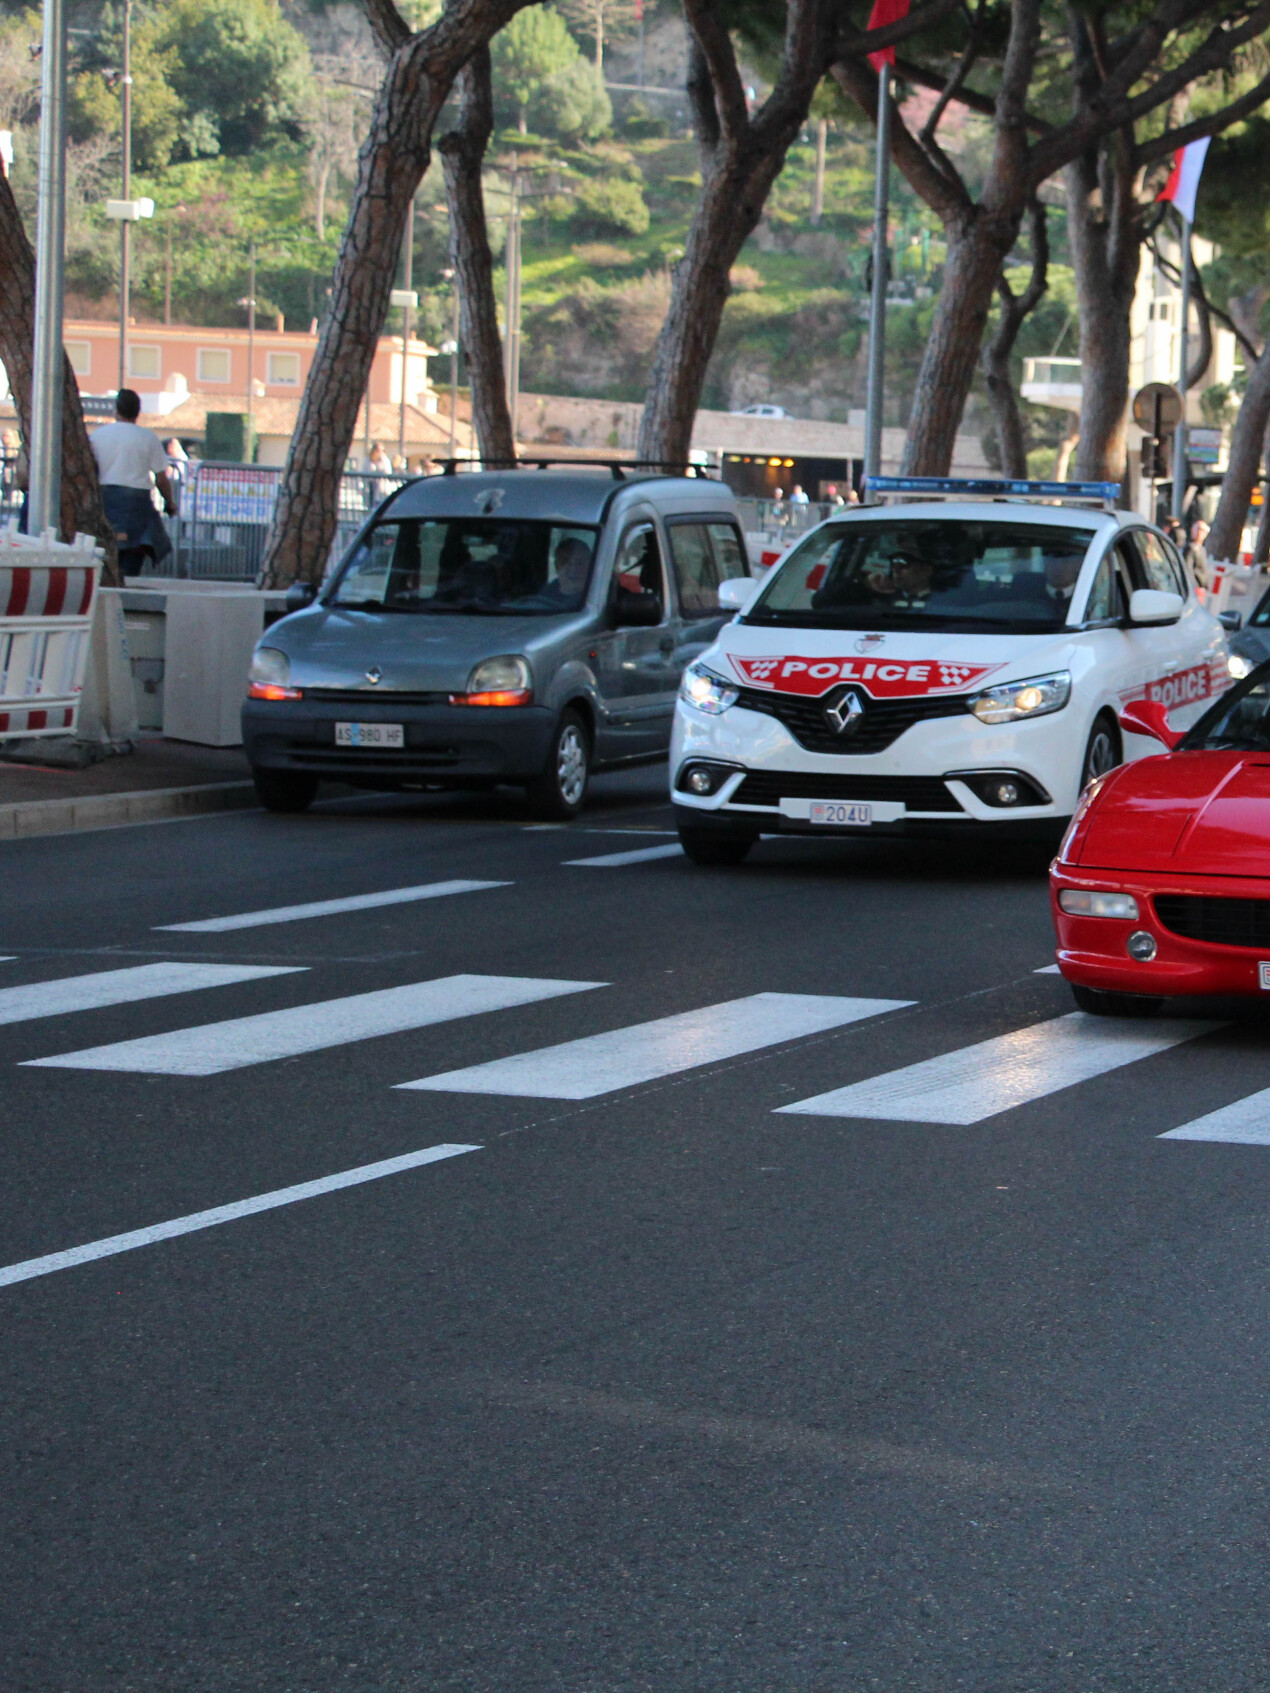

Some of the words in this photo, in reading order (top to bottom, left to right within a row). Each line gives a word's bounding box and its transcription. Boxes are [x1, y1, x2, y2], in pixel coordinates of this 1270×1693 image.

[781, 662, 931, 682] POLICE
[1150, 670, 1207, 707] POLICE
[826, 805, 868, 823] 204U
